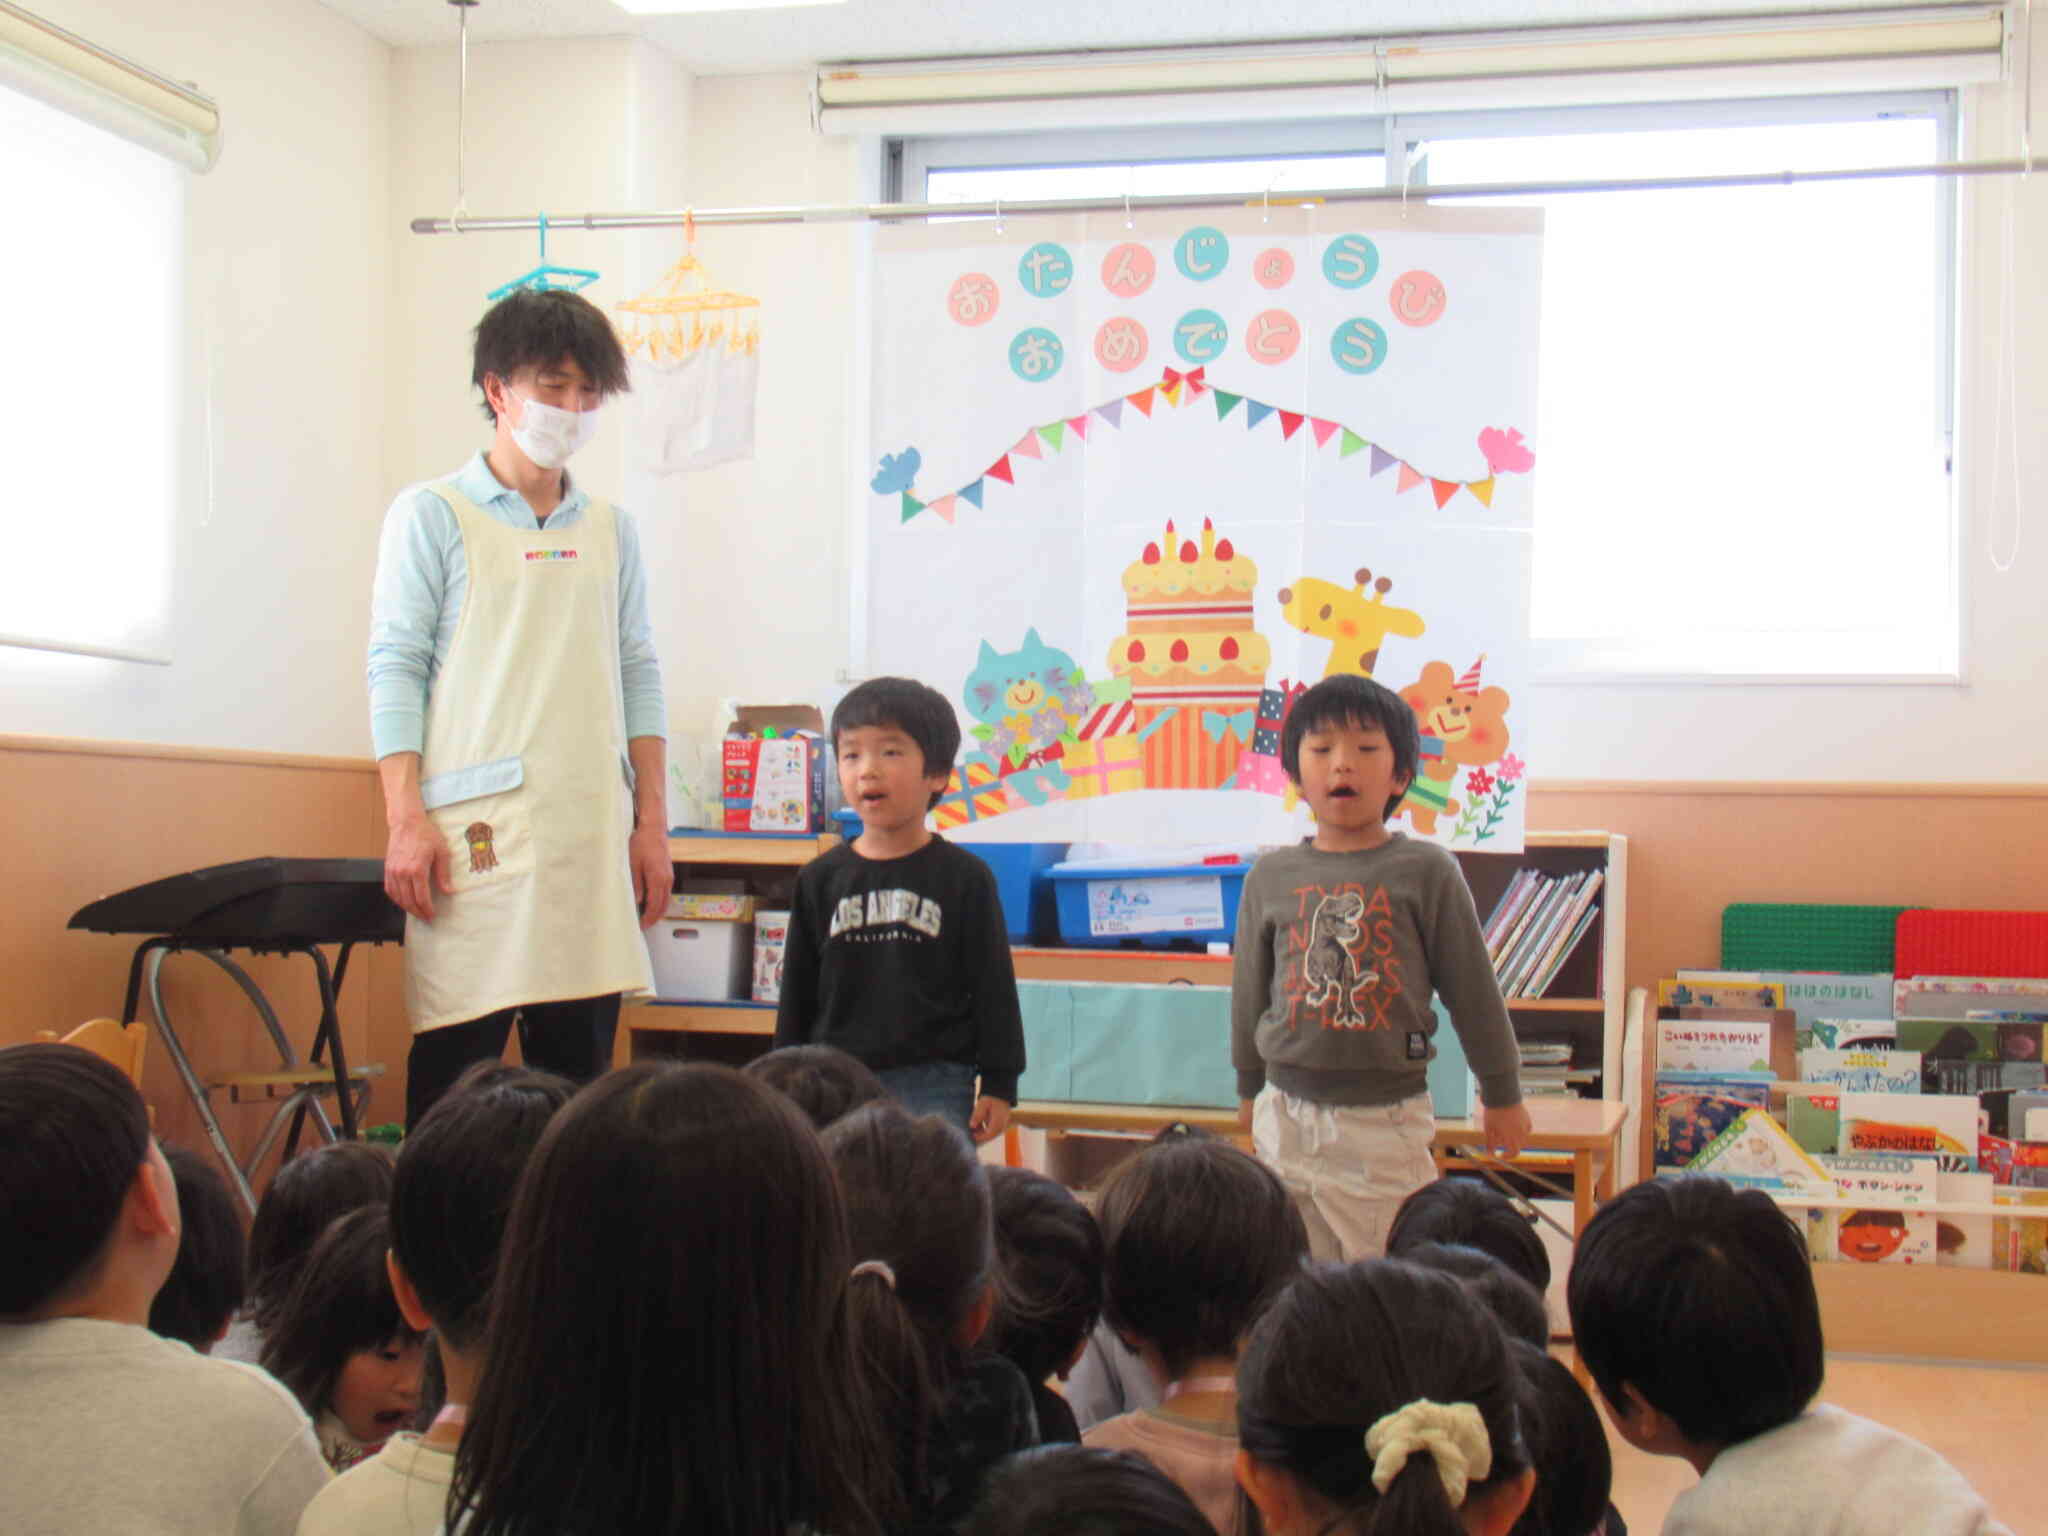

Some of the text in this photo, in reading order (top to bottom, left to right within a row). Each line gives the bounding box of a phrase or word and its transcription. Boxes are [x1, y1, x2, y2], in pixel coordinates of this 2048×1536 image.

[952, 236, 1446, 320] おたんじょうび
[1016, 316, 1378, 374] おめでとう
